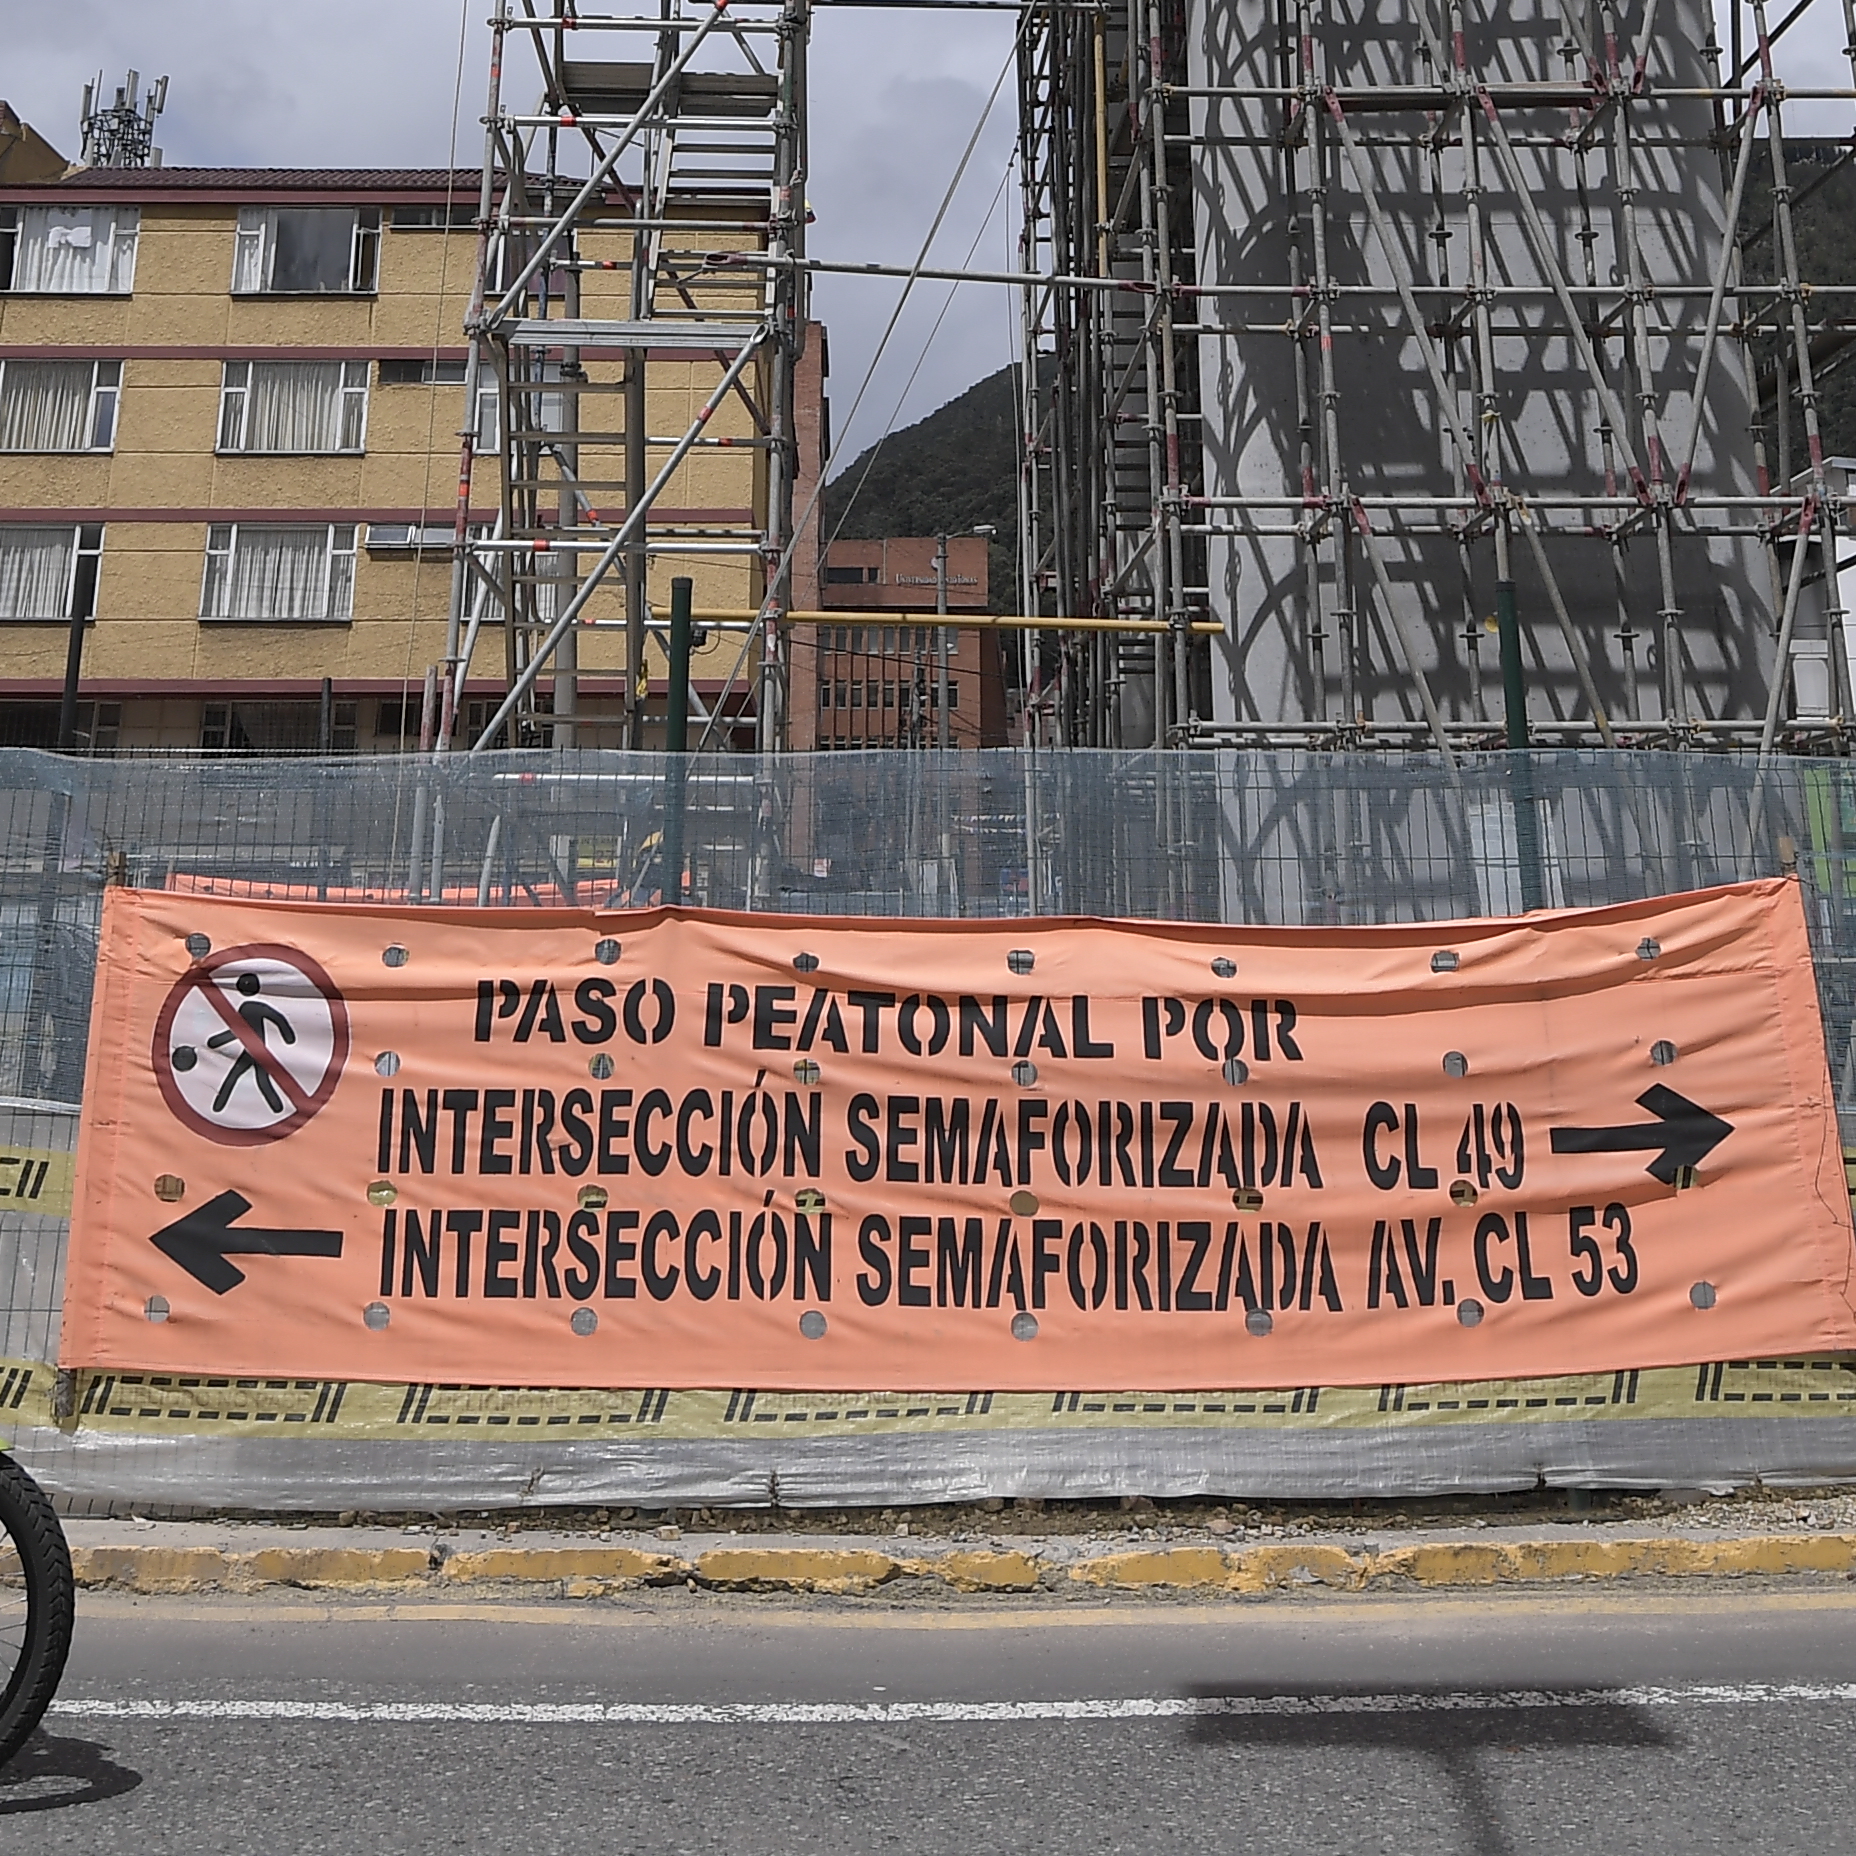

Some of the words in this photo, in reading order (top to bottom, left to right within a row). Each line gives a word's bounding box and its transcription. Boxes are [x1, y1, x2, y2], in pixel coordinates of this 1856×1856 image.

[474, 977, 676, 1045] PASO
[704, 982, 1114, 1058] PEATONAL
[1142, 995, 1304, 1061] POR
[377, 1069, 822, 1178] INTERSECCIÓN
[845, 1092, 1324, 1189] SEMAFORIZADA
[1363, 1101, 1439, 1190] CL
[1456, 1101, 1524, 1189] 49
[379, 1190, 832, 1302] INTERSECCIÓN
[856, 1214, 1344, 1312] SEMAFORIZADA
[1366, 1217, 1455, 1309] AV.
[1474, 1211, 1553, 1303] CL
[1569, 1202, 1638, 1297] 53
